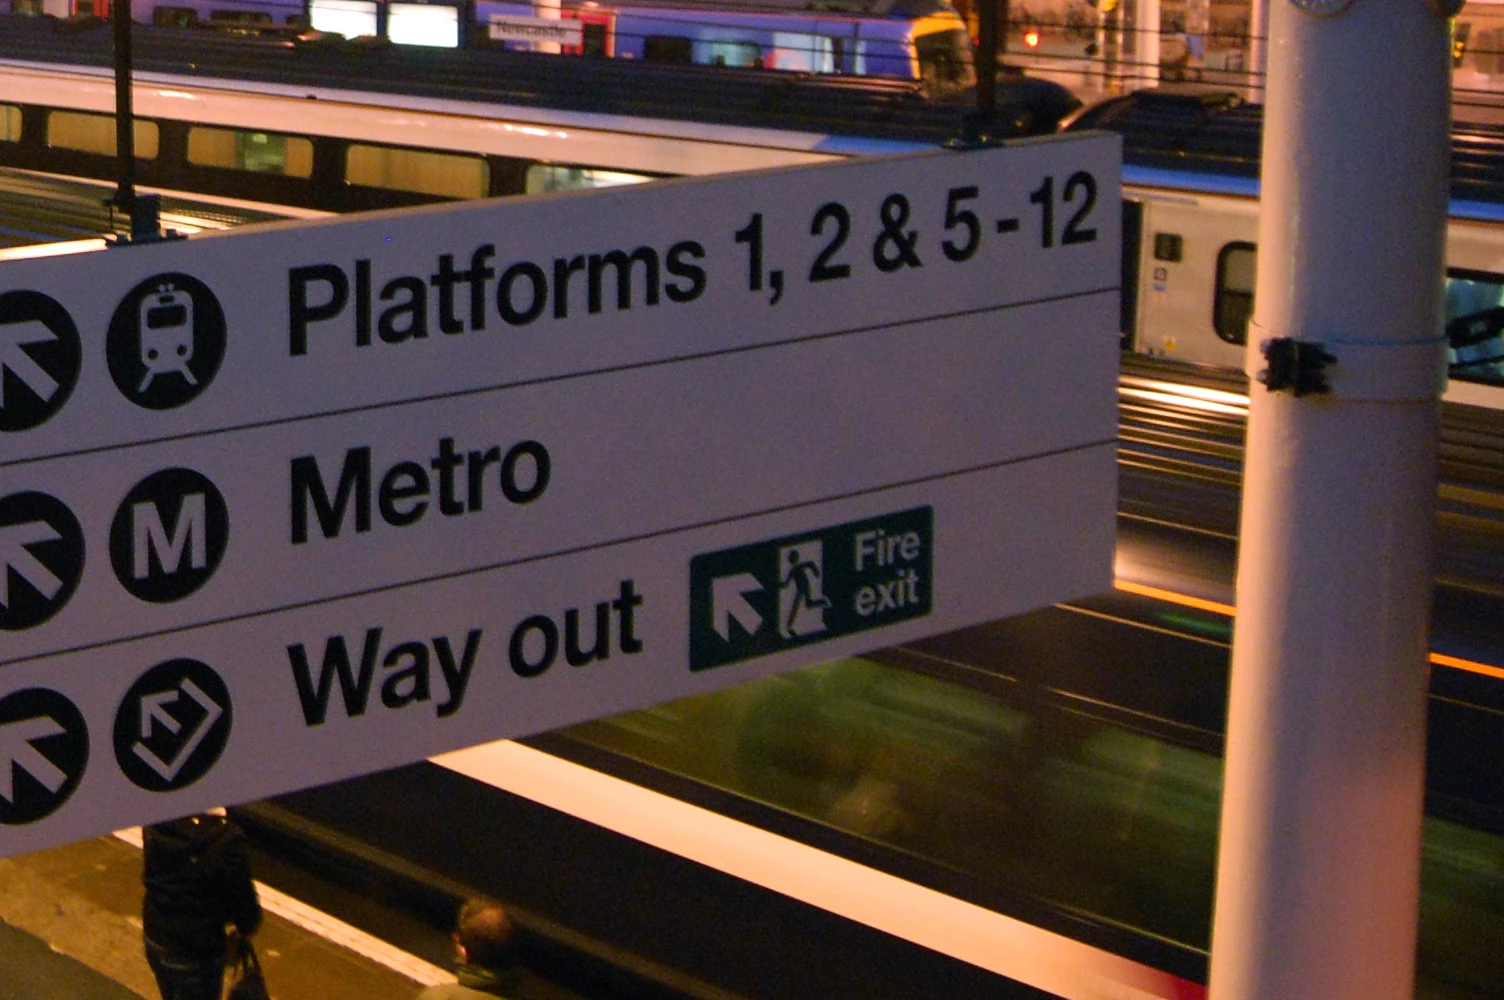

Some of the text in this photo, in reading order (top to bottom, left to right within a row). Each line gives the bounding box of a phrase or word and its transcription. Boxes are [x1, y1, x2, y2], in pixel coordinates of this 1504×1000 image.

[287, 240, 707, 358] Platforms
[735, 213, 784, 305] 1,
[809, 202, 851, 283] 2
[872, 192, 923, 273] &
[132, 436, 552, 582] M Metro
[854, 528, 921, 574] Fire
[286, 579, 644, 727] Way out
[855, 568, 921, 618] exit
